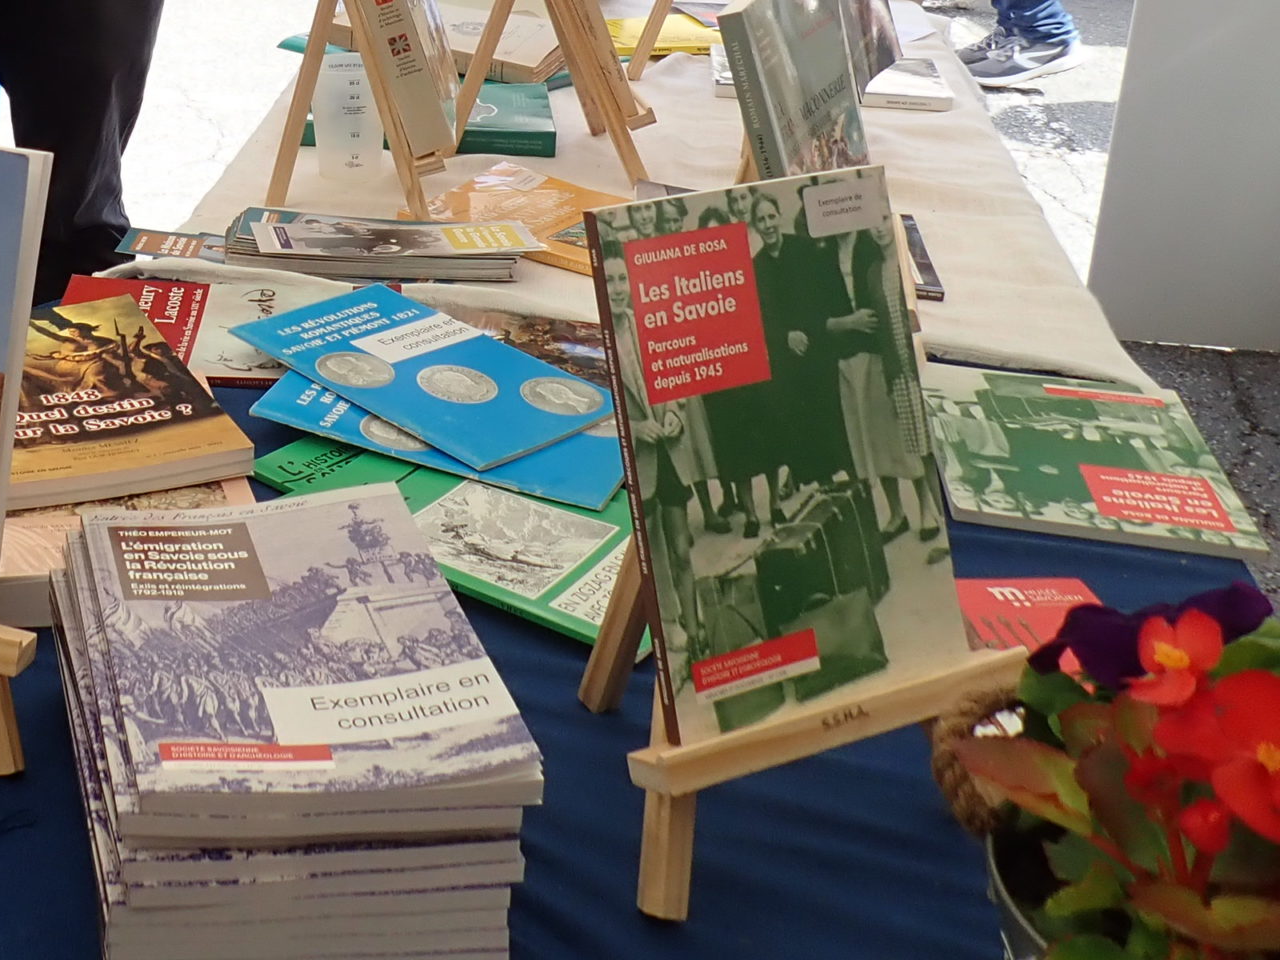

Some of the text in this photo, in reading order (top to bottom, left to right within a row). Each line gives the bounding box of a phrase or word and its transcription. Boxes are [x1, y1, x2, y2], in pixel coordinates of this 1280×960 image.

[634, 239, 728, 266] GIULIANA DE ROSA
[638, 269, 745, 303] Les Italiens
[154, 286, 185, 324] Lacoste
[644, 295, 737, 329] en Savoie
[277, 302, 379, 337] LES RÉVOLUTIONS
[299, 311, 380, 339] ROMANTIQUES
[282, 308, 421, 355] SAVOIE ET PIÉMONT 1821
[377, 321, 443, 346] Exemplaire
[402, 326, 470, 352] consultation
[648, 333, 697, 354] Parcours
[651, 341, 749, 372] et naturalisations
[654, 363, 723, 390] depuis 1945
[40, 389, 101, 406] 1848
[296, 388, 317, 407] LES
[16, 397, 155, 426] Quel destin
[50, 404, 193, 437] la Savoie ?
[1155, 486, 1209, 498] Parcours
[1162, 476, 1201, 486] depuis
[1102, 496, 1219, 518] Les Italiens
[1111, 489, 1213, 507] en Savoie
[1121, 509, 1152, 518] ROSA
[1155, 513, 1169, 521] DE
[118, 528, 233, 537] THÉO EMPEREUR-MOT
[121, 541, 224, 552] L'émigration
[123, 550, 249, 561] en Savoie sous
[125, 559, 236, 570] la Révolution
[128, 570, 209, 582] française
[131, 582, 157, 590] Exils
[170, 582, 247, 592] réintégrations
[311, 670, 491, 713] Exemplaire en
[337, 692, 491, 732] consultation
